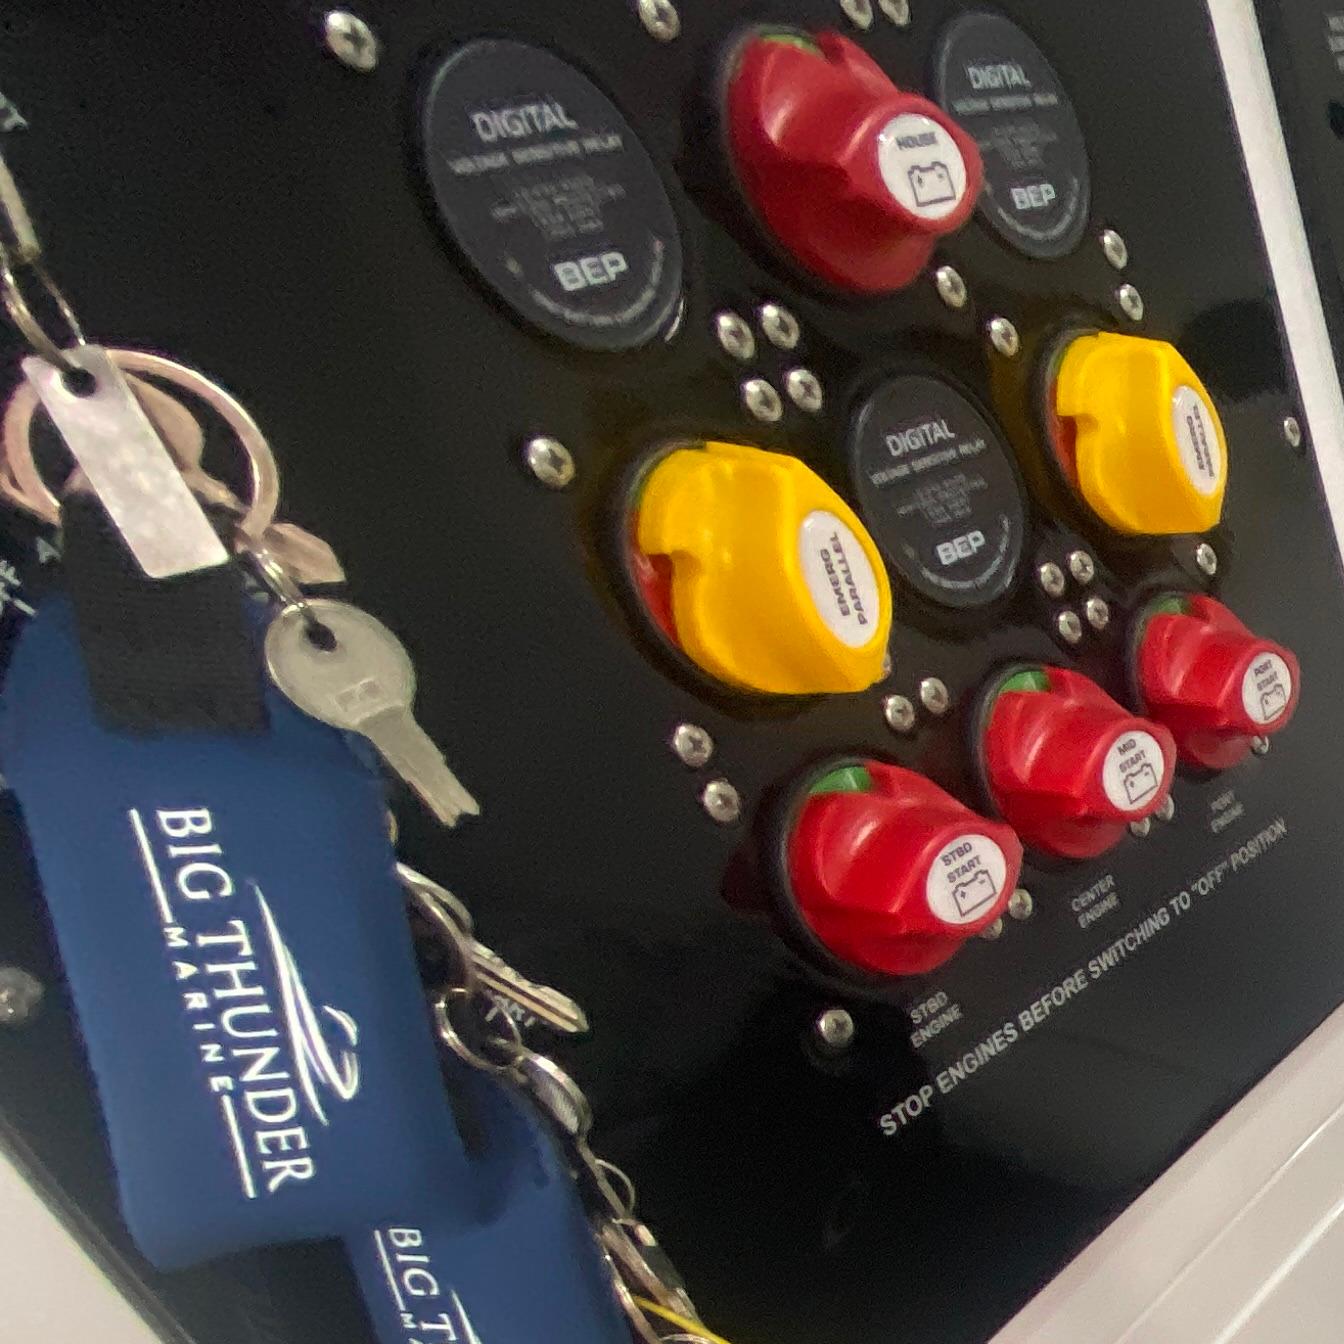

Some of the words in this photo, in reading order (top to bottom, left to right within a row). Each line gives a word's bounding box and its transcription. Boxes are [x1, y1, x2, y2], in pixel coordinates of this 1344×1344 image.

[967, 64, 1031, 88] DIGITAL
[471, 102, 578, 142] DIGITAL
[896, 132, 938, 149] HOUSE
[1011, 184, 1056, 210] BEP
[554, 252, 628, 291] BEP
[886, 419, 955, 457] DIGITAL
[936, 530, 985, 565] BEP
[820, 549, 850, 616] EMERG
[830, 531, 868, 625] PARALLEL
[1256, 671, 1279, 691] START
[1117, 739, 1137, 755] MID
[1118, 750, 1146, 773] START
[156, 808, 233, 900] BIG
[940, 841, 972, 866] STBD
[946, 854, 982, 882] START
[1071, 874, 1116, 911] CENTER
[1078, 892, 1121, 928] ENGINE
[880, 1085, 934, 1136] STOP
[936, 1022, 1018, 1094] ENGINES
[1018, 969, 1088, 1031] BEFORE
[1088, 906, 1170, 979] SWITCHING
[1169, 891, 1191, 915] TO
[1230, 816, 1287, 871] POSITION
[164, 926, 234, 1094] MARINE
[910, 991, 948, 1023] STBD
[911, 1004, 963, 1048] ENGINE
[196, 919, 315, 1194] THUNDER
[388, 1228, 440, 1296] BIG
